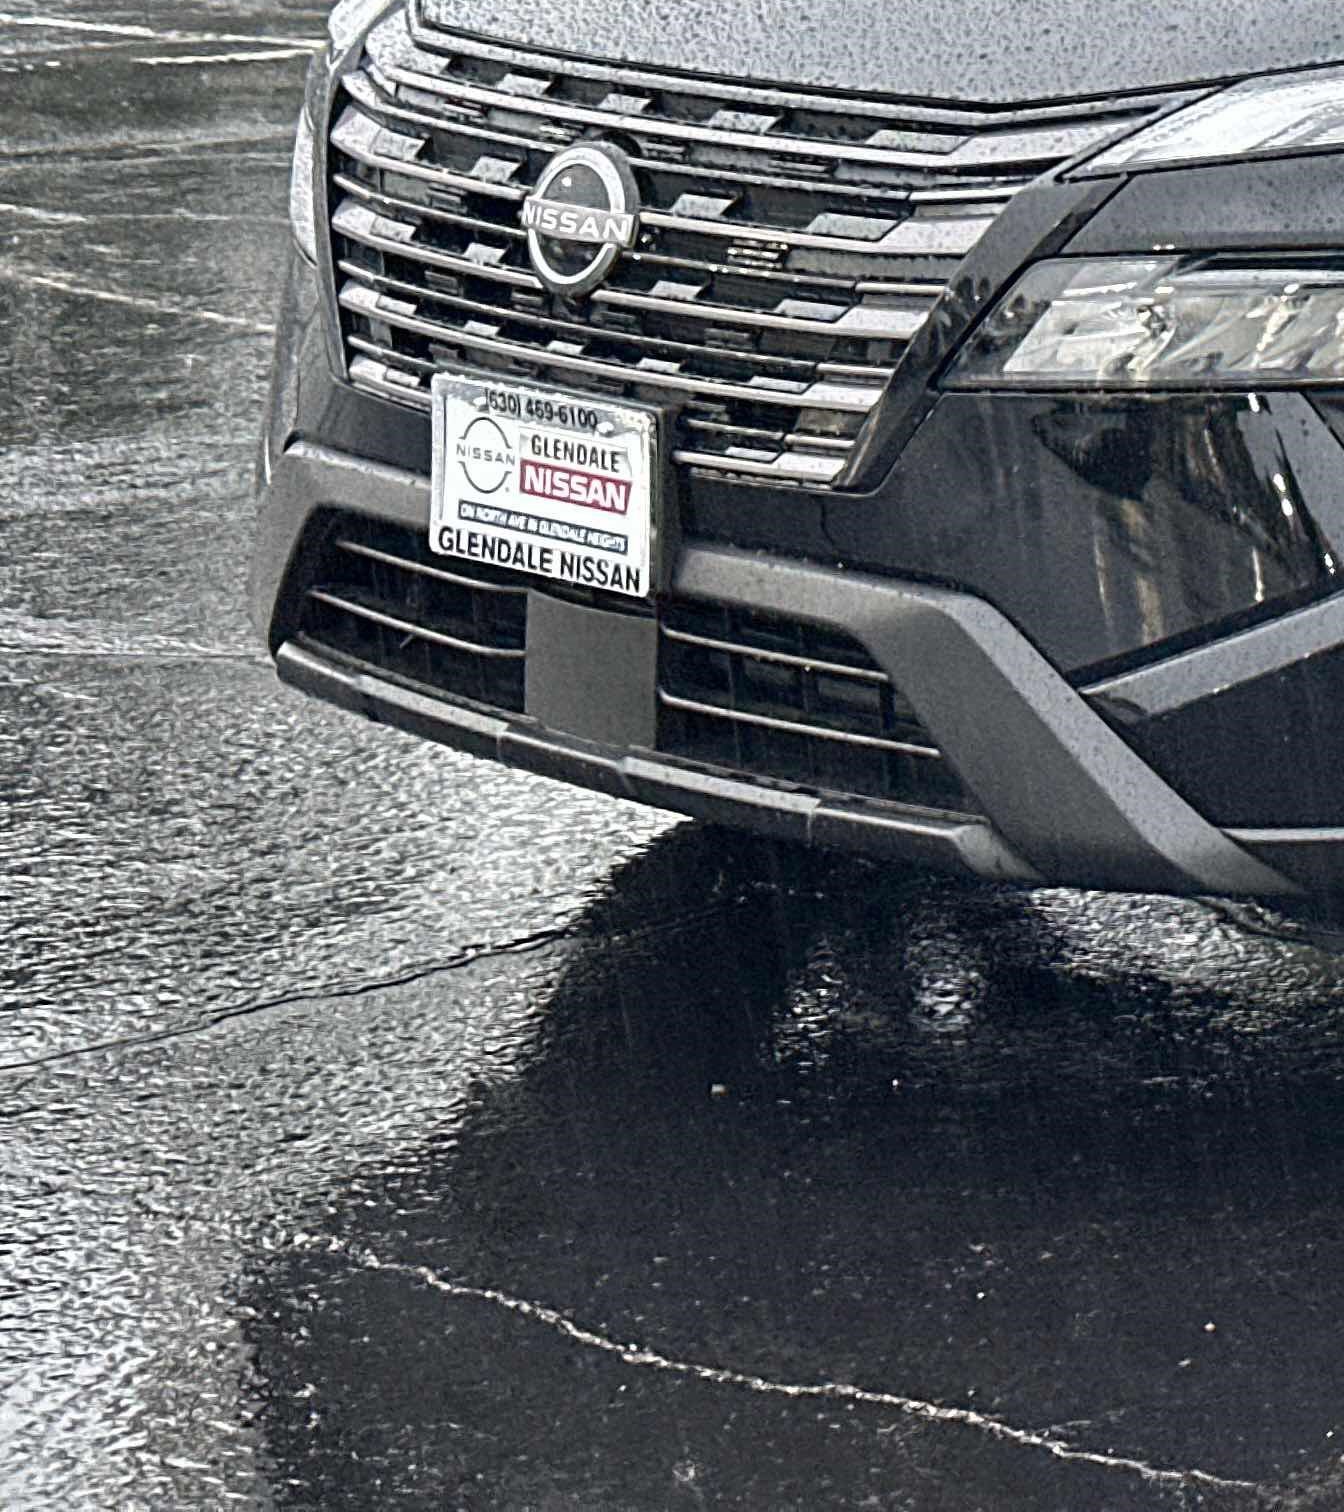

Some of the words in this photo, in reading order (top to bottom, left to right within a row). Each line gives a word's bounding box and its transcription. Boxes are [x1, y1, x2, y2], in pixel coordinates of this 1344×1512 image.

[521, 199, 628, 242] NISSAN
[485, 387, 521, 418] (630)
[526, 398, 598, 430] 469-6100
[456, 444, 515, 466] NISSAN
[531, 434, 619, 473] GLENDALE
[525, 465, 626, 511] NISSAN
[438, 525, 553, 574] GLENDALE
[560, 550, 641, 594] NISSAN
